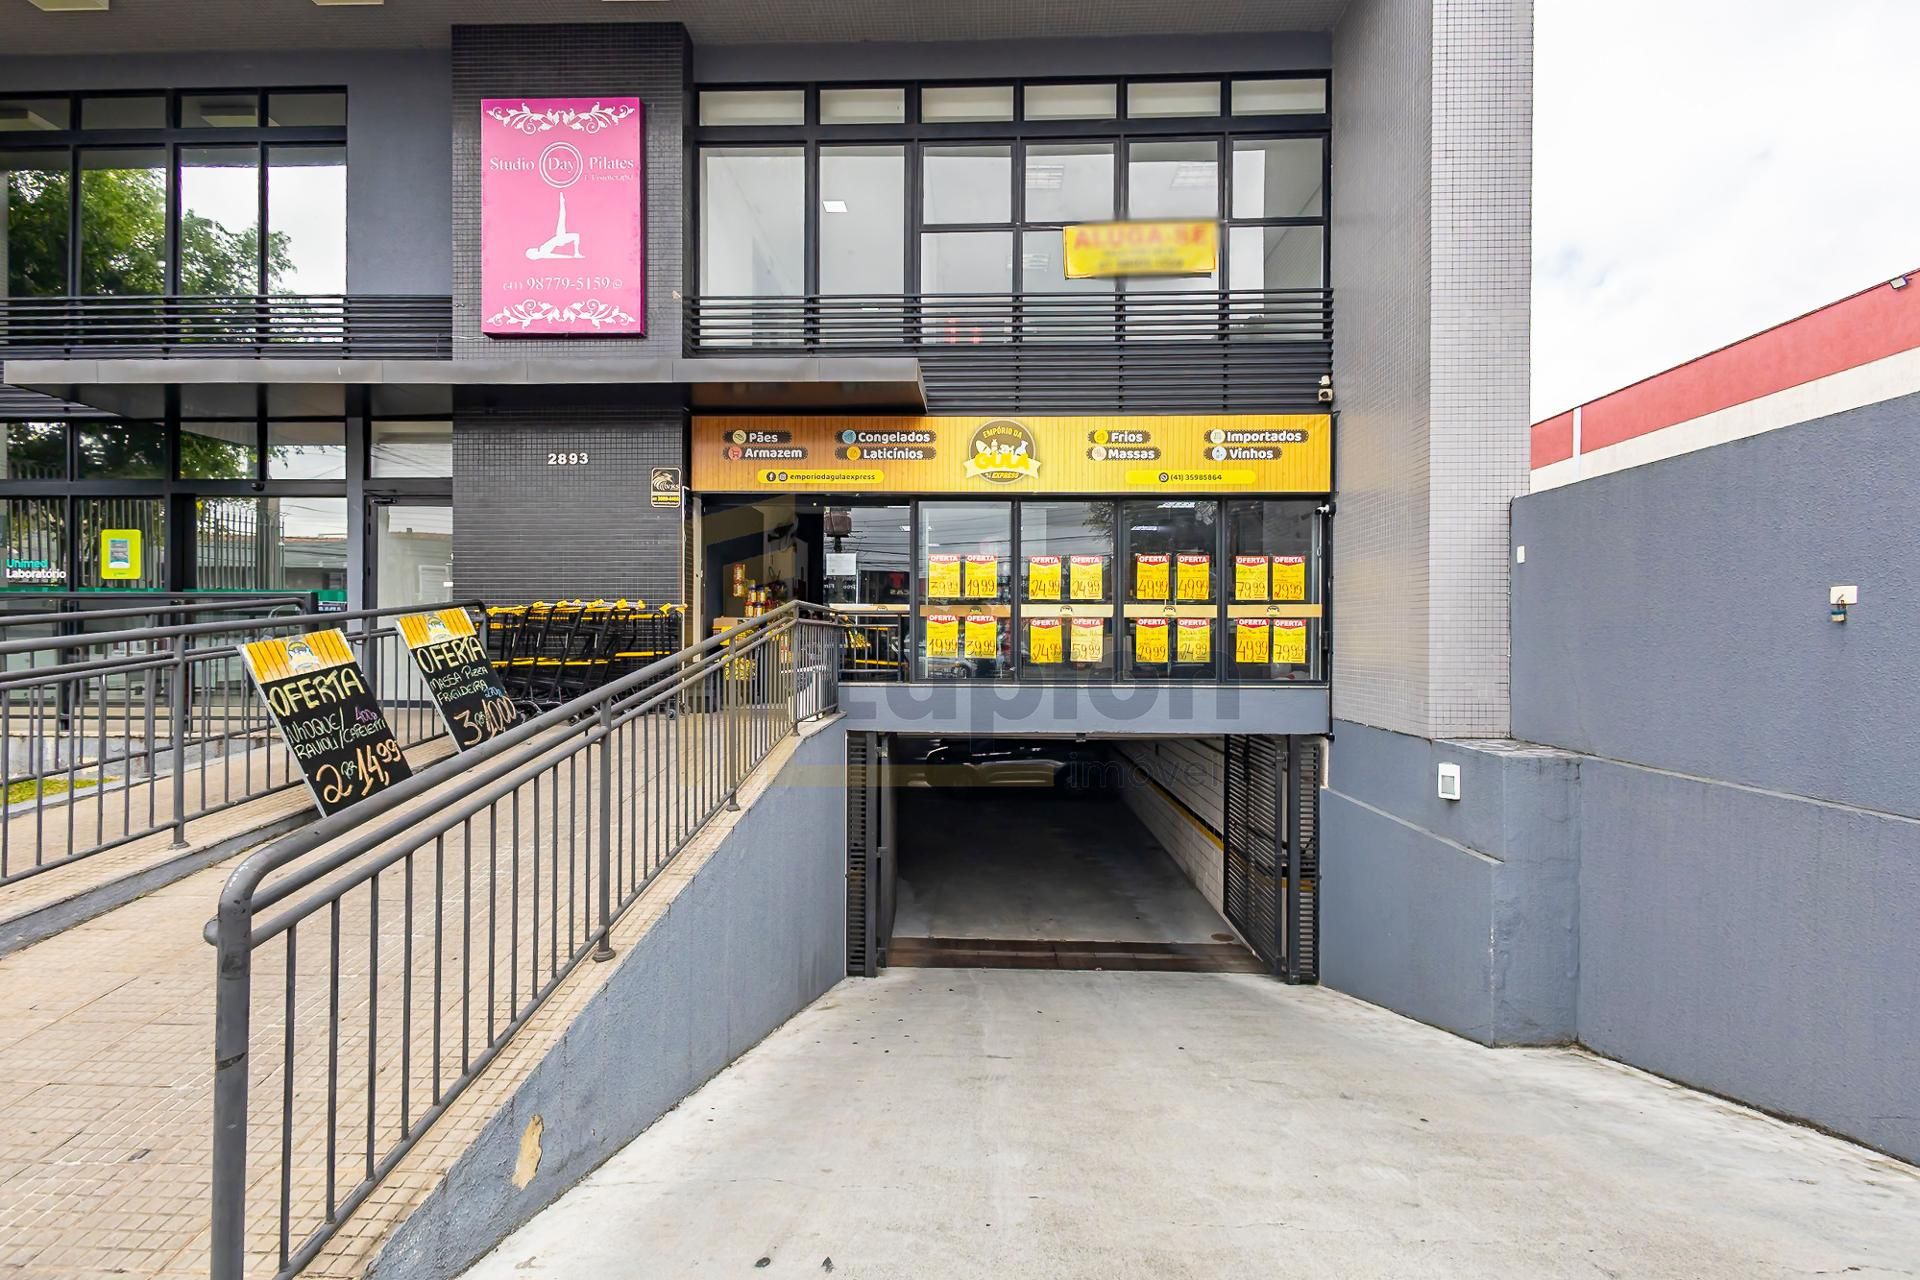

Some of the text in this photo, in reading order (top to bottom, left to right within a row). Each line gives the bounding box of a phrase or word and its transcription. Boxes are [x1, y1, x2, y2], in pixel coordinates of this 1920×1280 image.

[489, 156, 634, 174] Studio Day Pilates
[526, 276, 610, 291] 98779-5159
[749, 431, 778, 444] Pães
[858, 431, 931, 446] Congelados
[1110, 431, 1143, 443] Frios
[1226, 431, 1303, 445] Importados
[547, 452, 589, 465] 2893
[744, 447, 803, 459] Armazem
[862, 447, 924, 460] Laticínios
[1107, 448, 1155, 460] Massas
[1229, 448, 1274, 460] Vinhos
[789, 473, 876, 483] emporiodagulaexpress
[1170, 474, 1184, 482] (41)
[6, 559, 49, 569] Unimed
[1179, 555, 1207, 563] OFERTA
[5, 568, 67, 580] Laboratório
[1275, 619, 1303, 627] OFERTA
[416, 636, 487, 674] OFERTA
[429, 671, 463, 691] MASSA
[267, 667, 366, 718] OFERTA
[453, 709, 483, 746] 3
[315, 763, 354, 804] 2
[355, 738, 402, 797] 14,99
